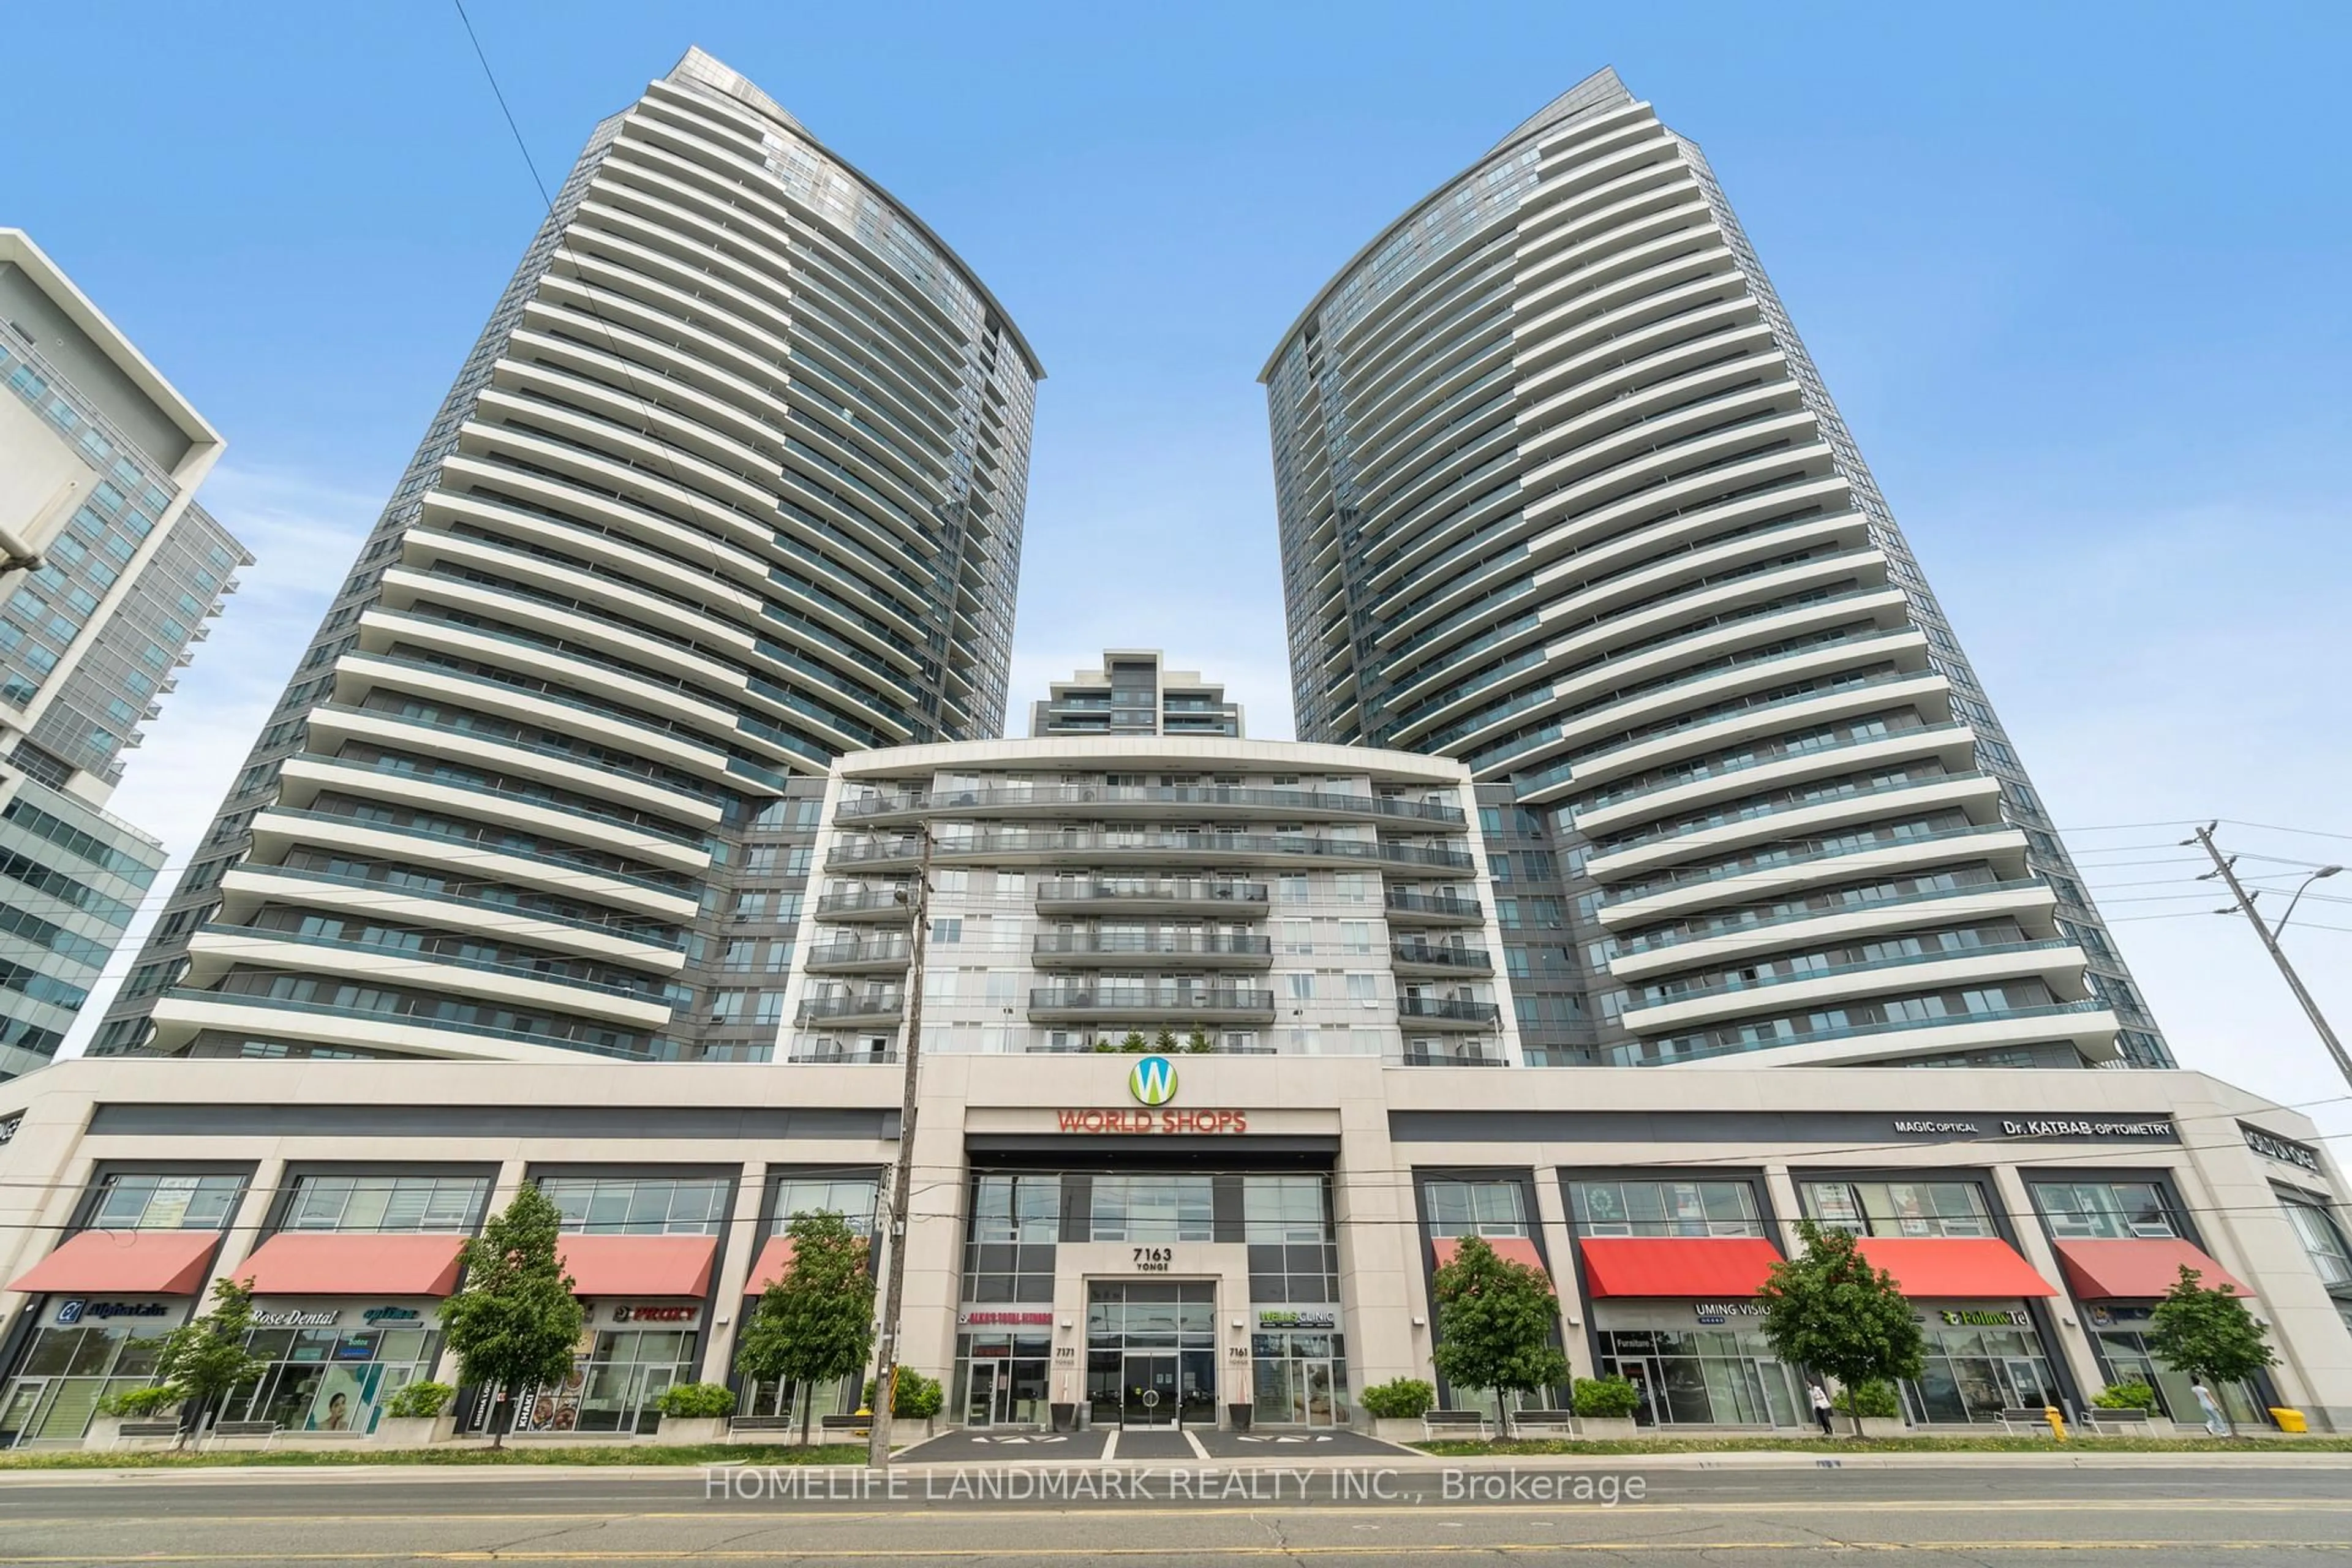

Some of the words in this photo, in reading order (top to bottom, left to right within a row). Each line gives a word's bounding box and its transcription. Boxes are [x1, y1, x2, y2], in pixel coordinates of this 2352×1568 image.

[1136, 1061, 1173, 1102] W
[1058, 1110, 1153, 1133] WORLD
[1162, 1109, 1247, 1133] SHOPS
[1894, 1121, 1935, 1133] MAGIC
[1936, 1123, 1979, 1133] OPTICAL
[2002, 1121, 2027, 1134] Dr.
[2027, 1121, 2092, 1134] KATBAB
[2095, 1124, 2170, 1134] OPTOMETRY
[1133, 1248, 1172, 1262] 7163
[633, 1306, 698, 1322] PROXY
[1298, 1311, 1335, 1322] CLINIC
[1695, 1304, 1736, 1316] UMING
[253, 1310, 284, 1324] Rose
[285, 1309, 339, 1325] Dental
[1056, 1347, 1074, 1357] 7171
[1229, 1347, 1248, 1357] 7161
[519, 1394, 534, 1427] KHAKI
